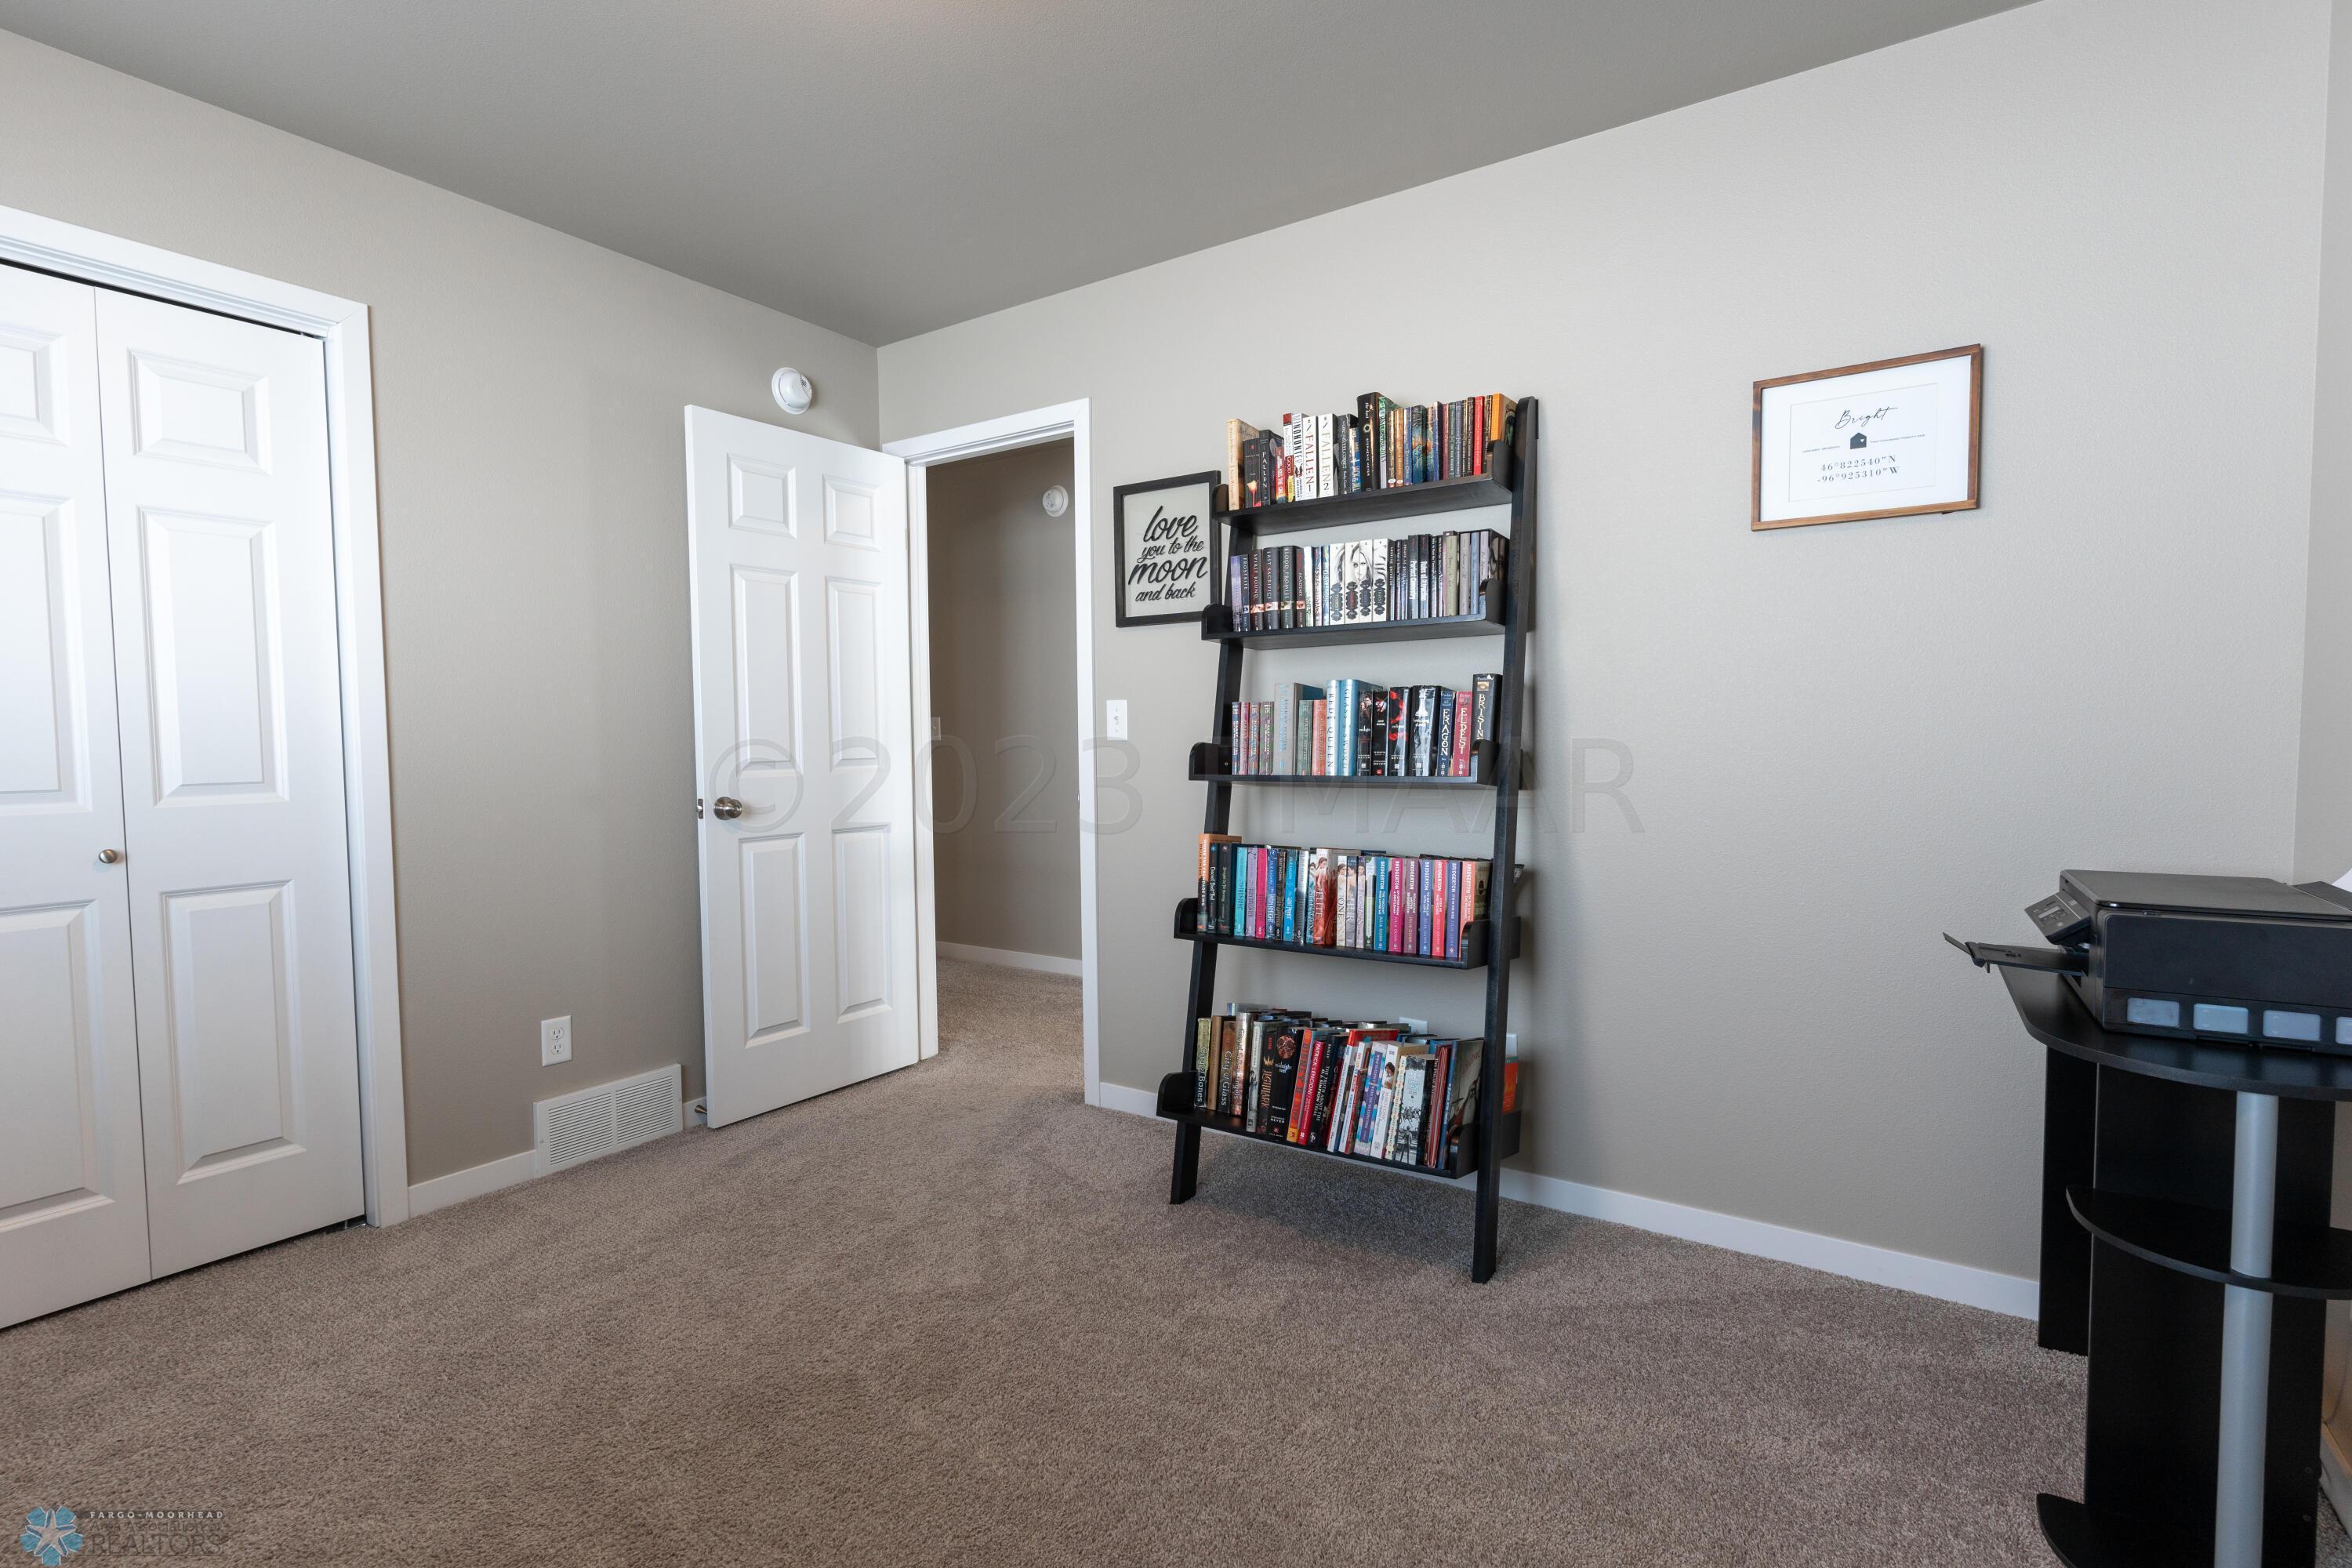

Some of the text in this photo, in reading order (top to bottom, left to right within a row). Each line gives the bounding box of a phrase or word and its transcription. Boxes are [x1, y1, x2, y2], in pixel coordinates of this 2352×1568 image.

[1835, 406, 1898, 429] Bright
[1294, 416, 1302, 463] MINDHUNTER
[1305, 435, 1314, 484] FALLEN
[1322, 433, 1330, 482] FALLEN
[1143, 505, 1199, 543] love
[1137, 535, 1204, 563] you to the
[1128, 556, 1208, 585] moon
[1135, 582, 1196, 601] and back
[1459, 708, 1468, 754] ELDEST
[1346, 898, 1355, 921] HEIR
[1222, 1051, 1232, 1070] City
[1275, 1062, 1292, 1070] midnight
[1308, 1044, 1321, 1094] PATRICK LENCIONI
[1223, 1073, 1229, 1081] of
